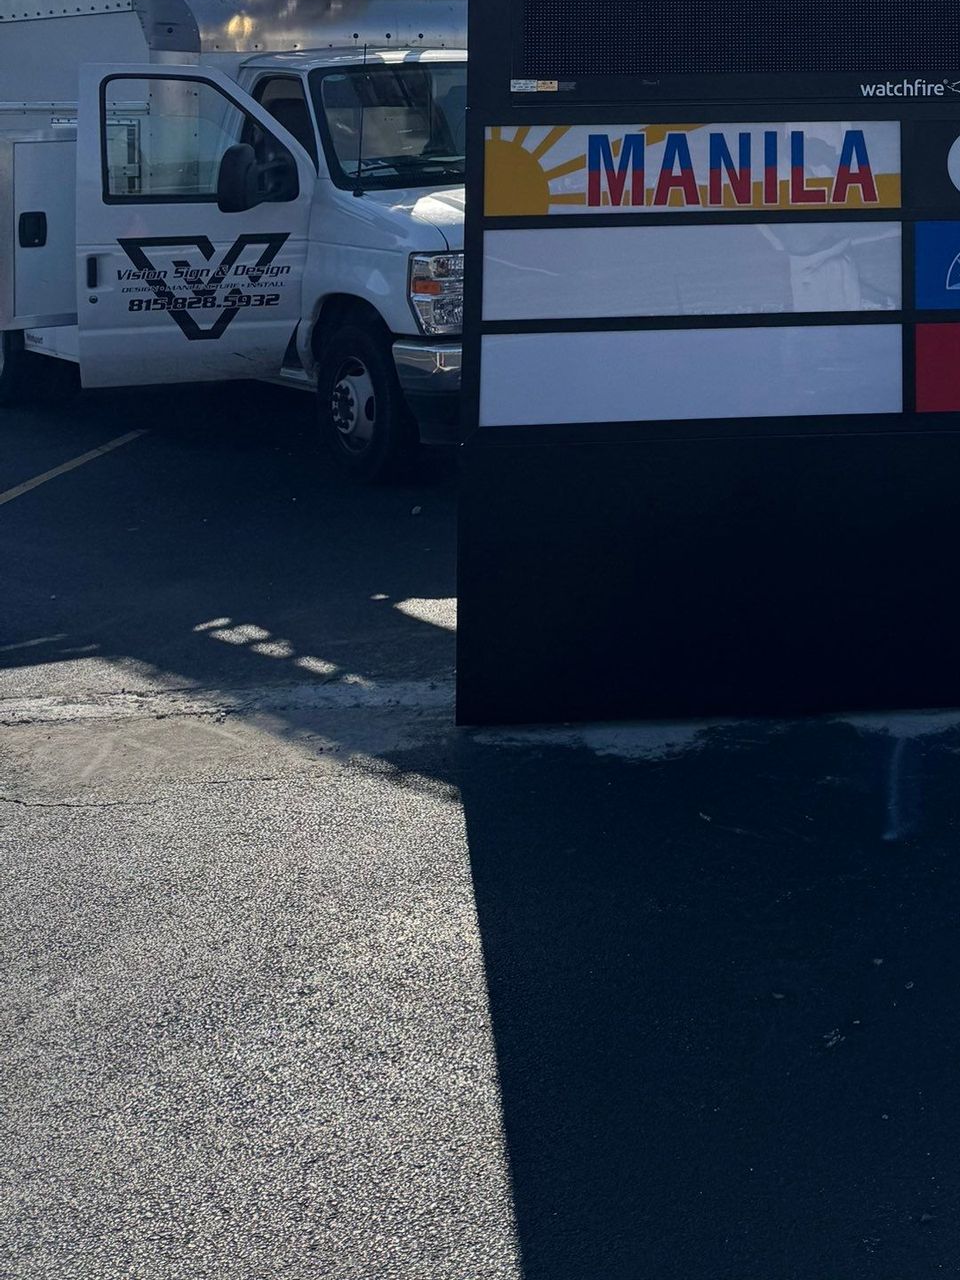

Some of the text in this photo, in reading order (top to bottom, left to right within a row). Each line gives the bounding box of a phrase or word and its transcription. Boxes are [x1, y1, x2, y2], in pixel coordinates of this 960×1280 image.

[860, 78, 945, 97] watchfire
[587, 128, 881, 208] MANILA
[116, 263, 291, 282] Vision Sign & Design
[246, 280, 286, 289] INSTALL
[128, 293, 281, 312] 815.828.5932
